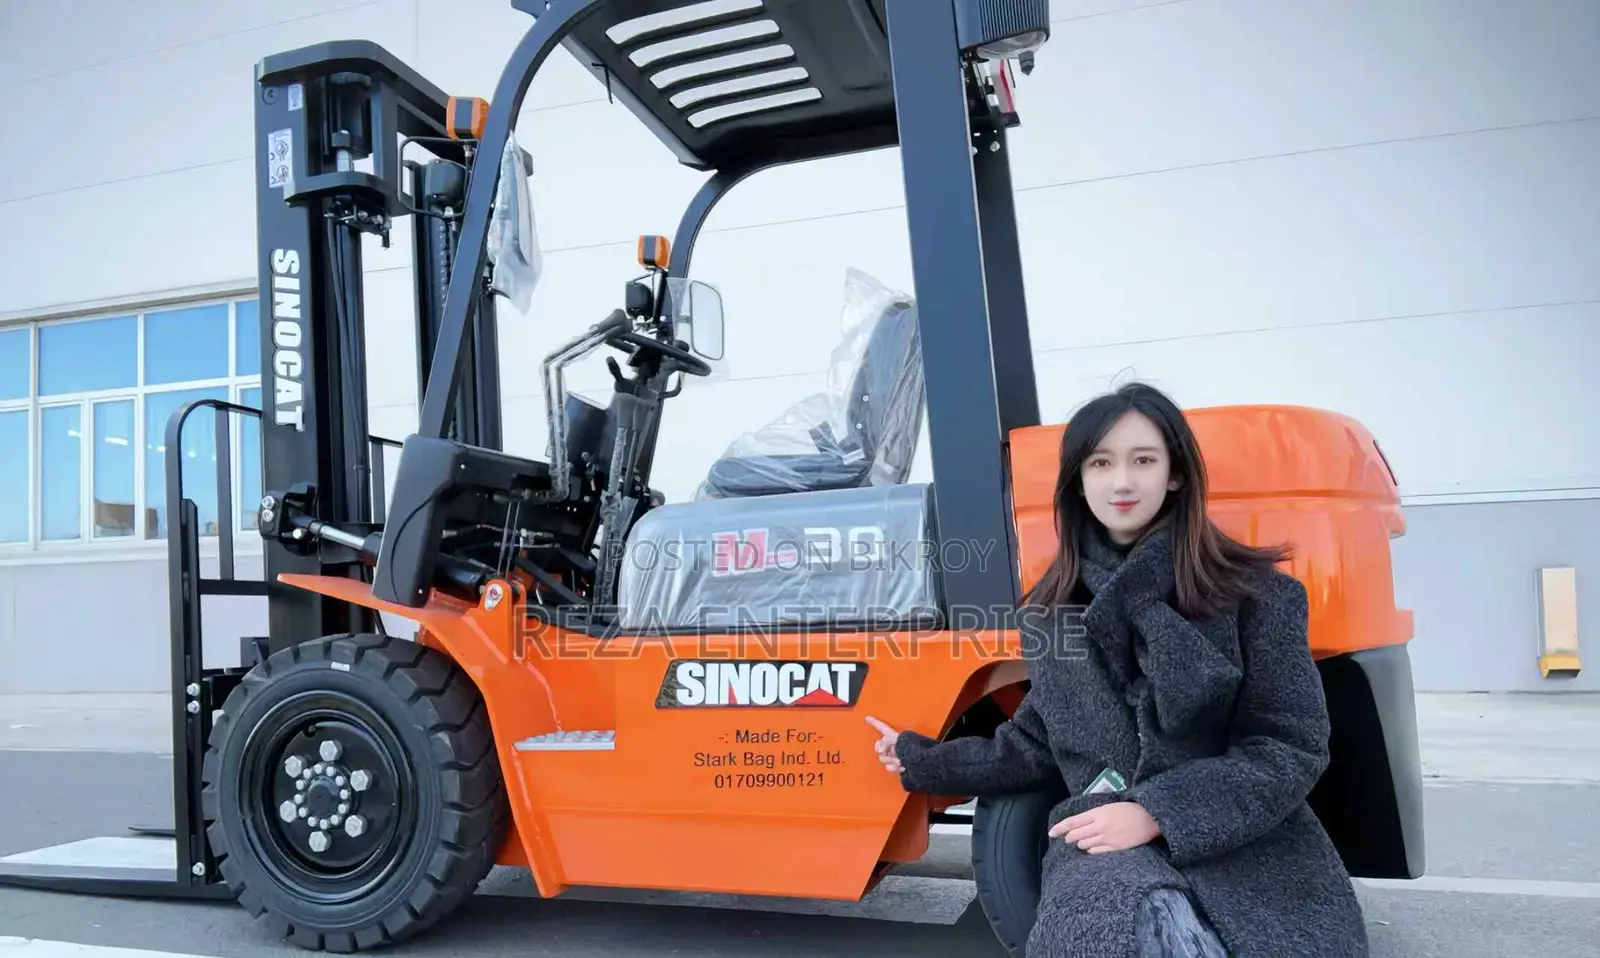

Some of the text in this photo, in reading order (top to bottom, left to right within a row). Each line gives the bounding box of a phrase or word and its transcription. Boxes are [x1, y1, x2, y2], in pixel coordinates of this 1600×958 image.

[272, 248, 304, 432] SINOCAT
[675, 661, 857, 706] SINOCAT
[735, 729, 781, 744] Made
[693, 750, 845, 769] Stark Bag Ind. Ltd.
[714, 772, 824, 789] 01709900121
